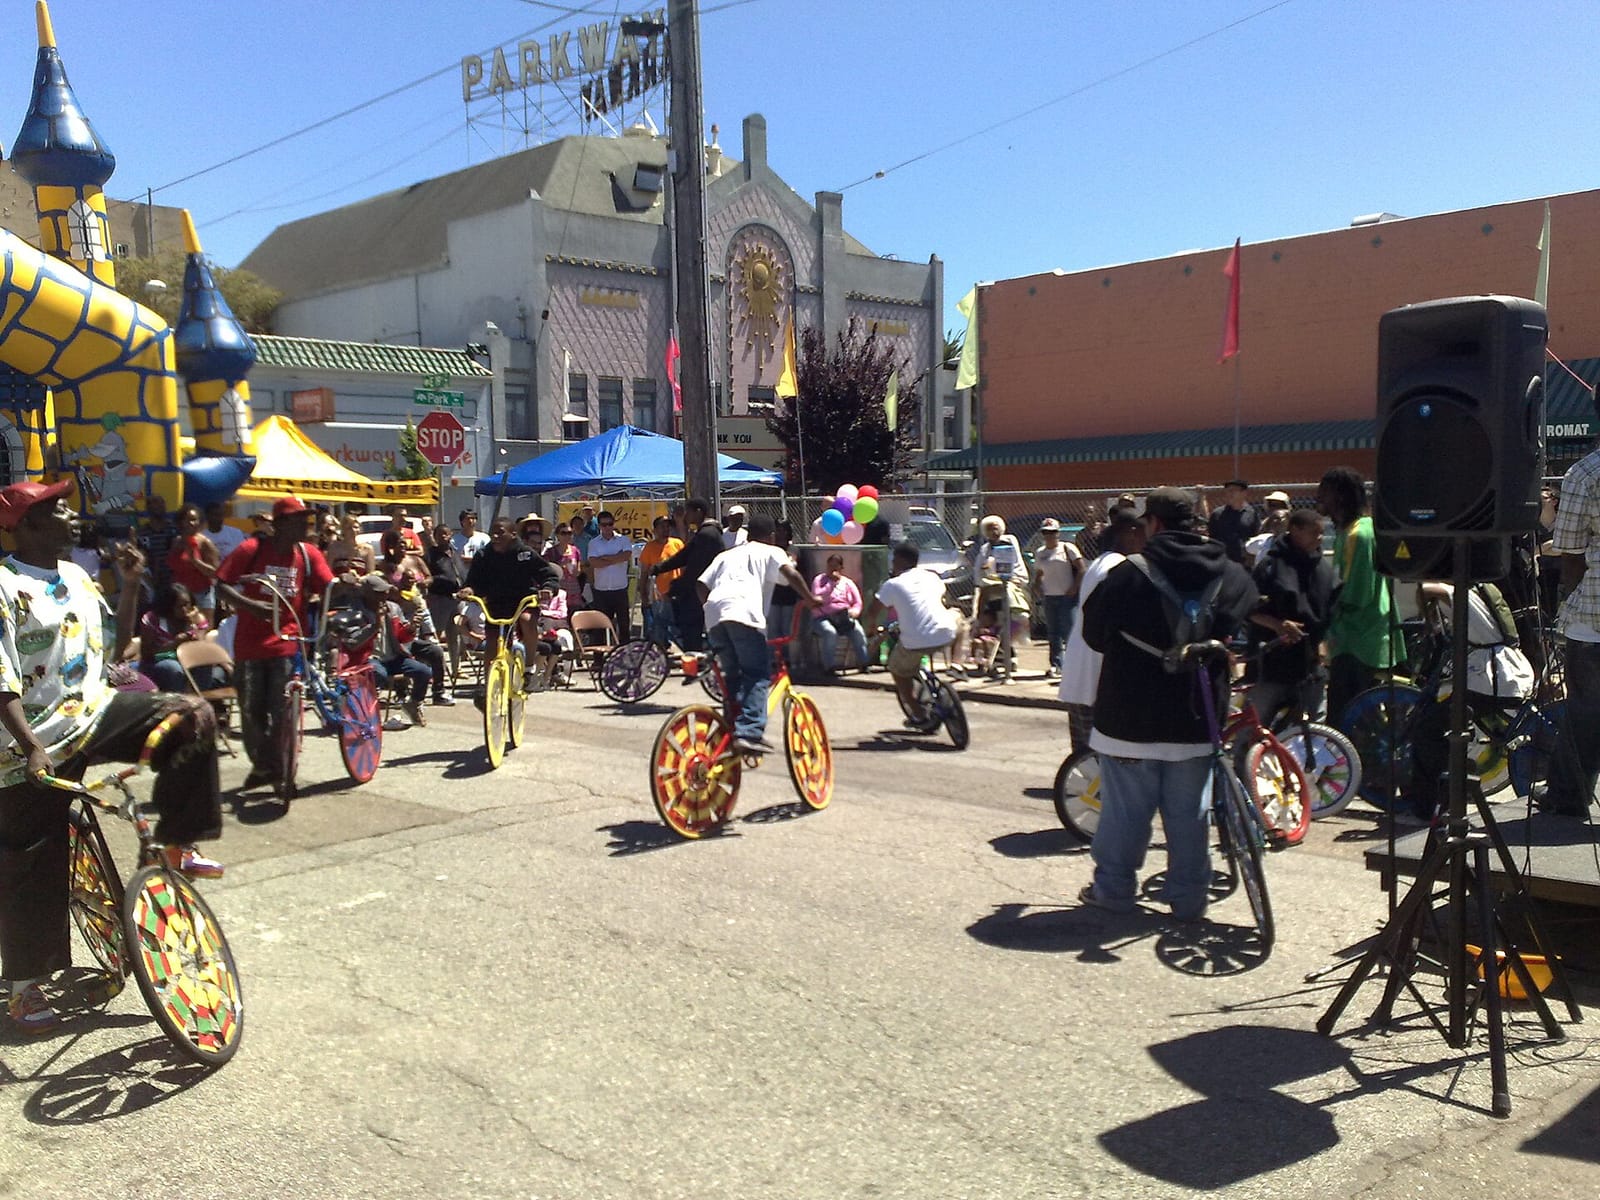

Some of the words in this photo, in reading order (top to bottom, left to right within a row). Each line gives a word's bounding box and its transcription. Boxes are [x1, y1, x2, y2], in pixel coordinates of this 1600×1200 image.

[461, 7, 667, 103] PARKWAY
[427, 392, 449, 405] Park
[1537, 423, 1590, 437] ROMAT
[418, 427, 463, 449] STOP
[717, 433, 728, 443] NK
[733, 433, 752, 443] YOU
[302, 479, 360, 491] ALERTA
[614, 506, 639, 525] Cafe
